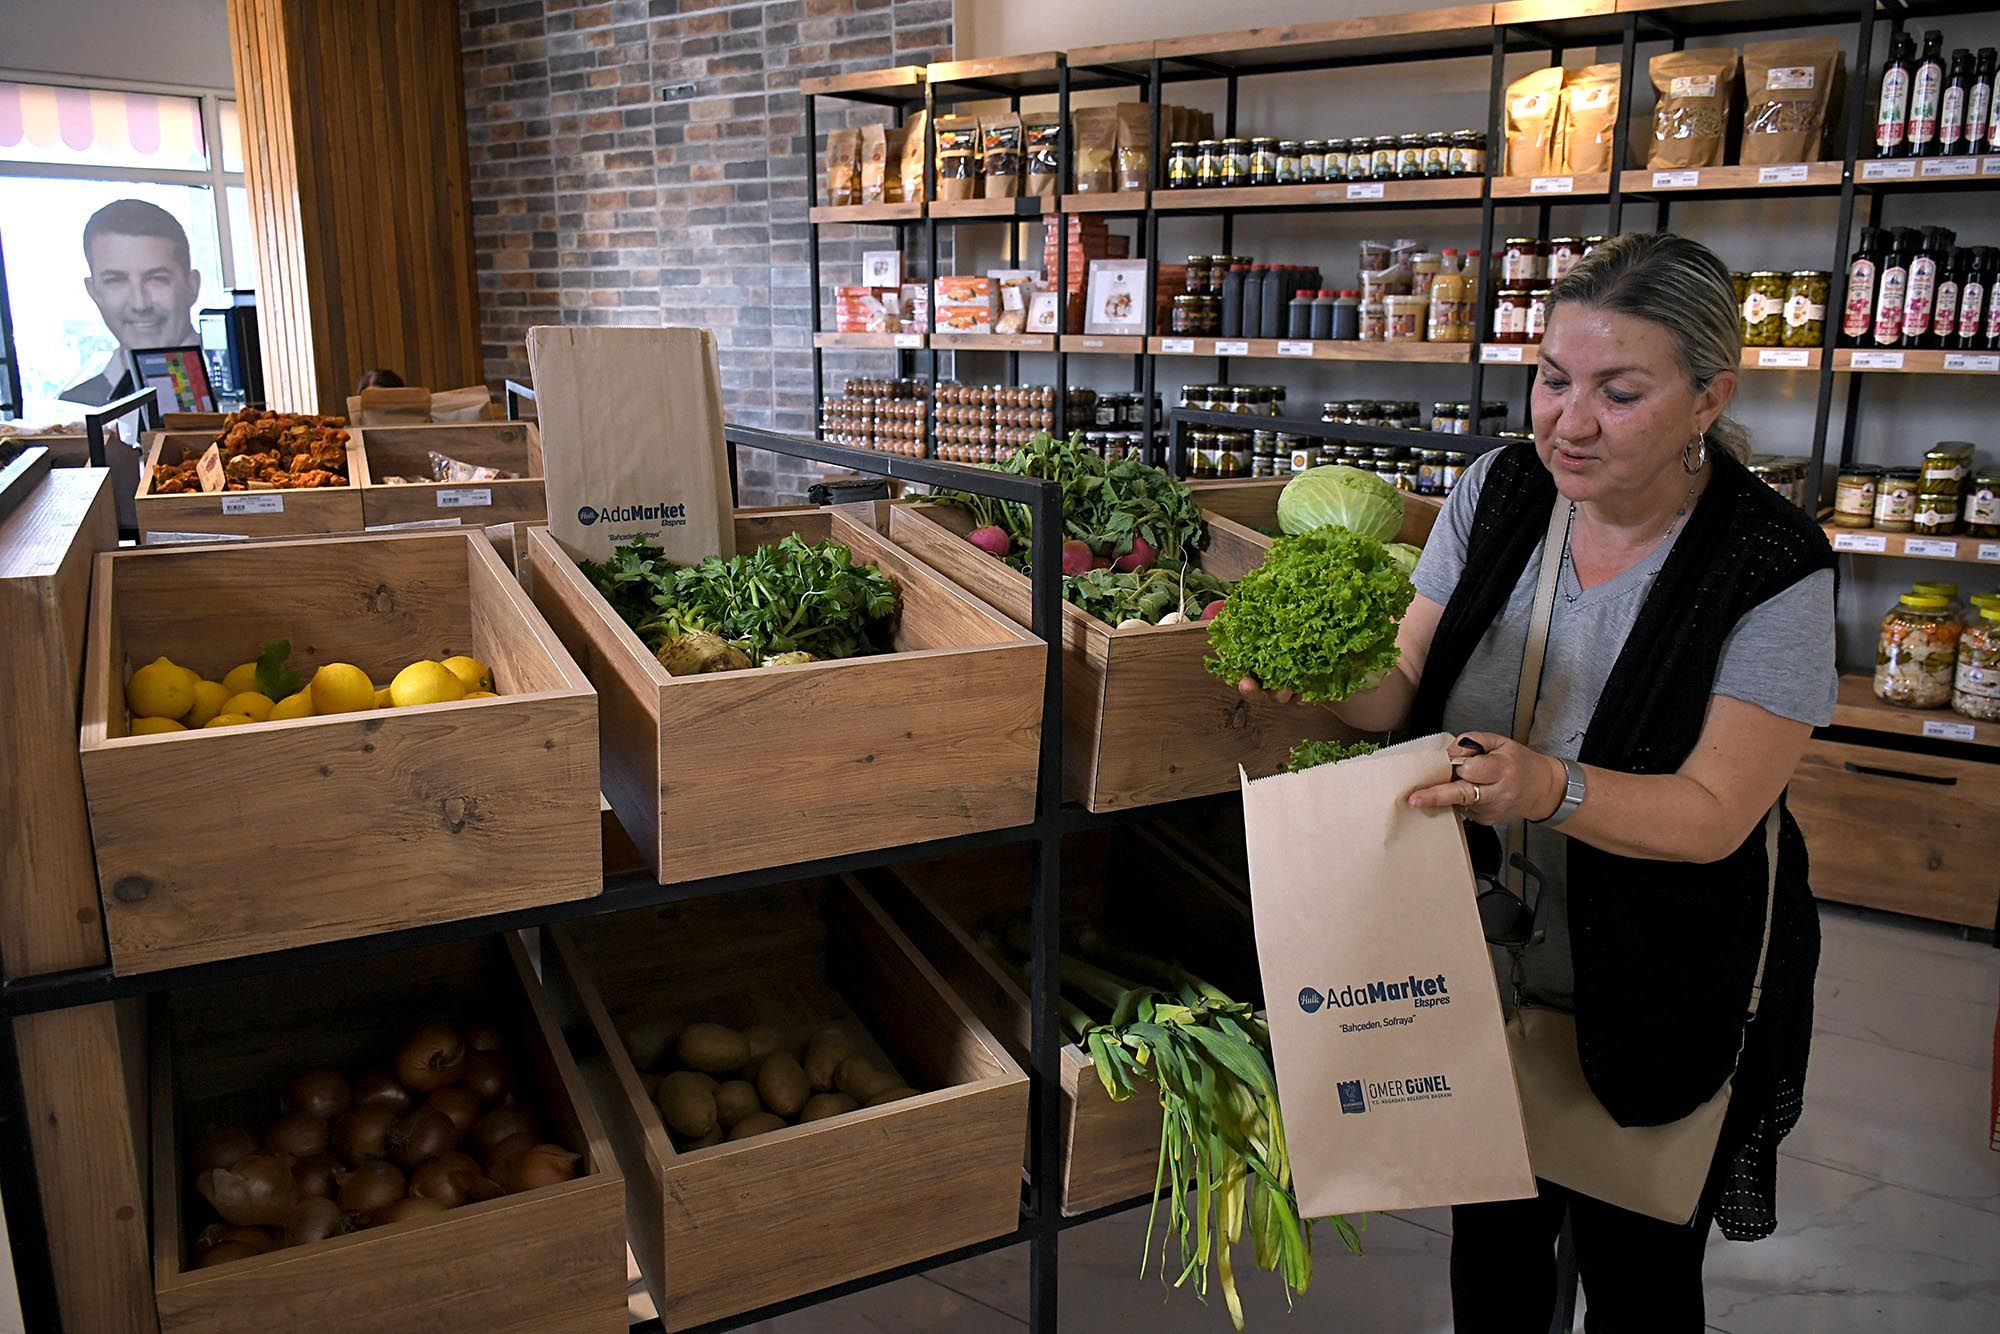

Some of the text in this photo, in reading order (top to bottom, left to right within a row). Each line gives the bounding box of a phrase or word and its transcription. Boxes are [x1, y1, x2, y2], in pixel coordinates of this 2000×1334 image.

[600, 503, 685, 523] AdaMarket
[1326, 974, 1448, 1009] AdaMarket
[1414, 996, 1450, 1008] Ekspres
